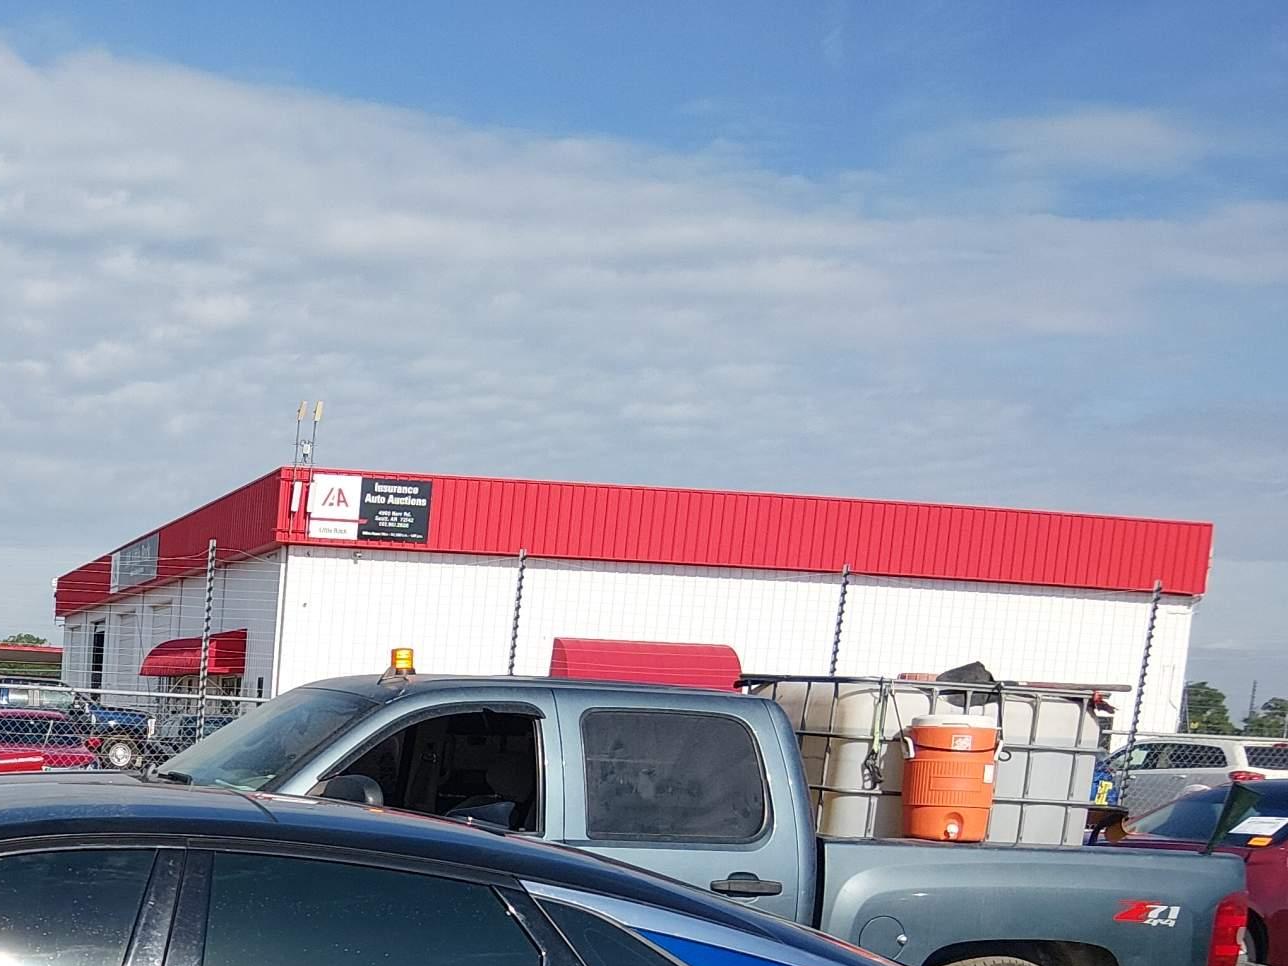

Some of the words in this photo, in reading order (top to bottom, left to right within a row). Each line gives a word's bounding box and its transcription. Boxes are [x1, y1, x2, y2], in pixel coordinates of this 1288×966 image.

[374, 482, 419, 495] Insurance
[364, 493, 386, 504] Auto
[387, 495, 427, 506] Auctions
